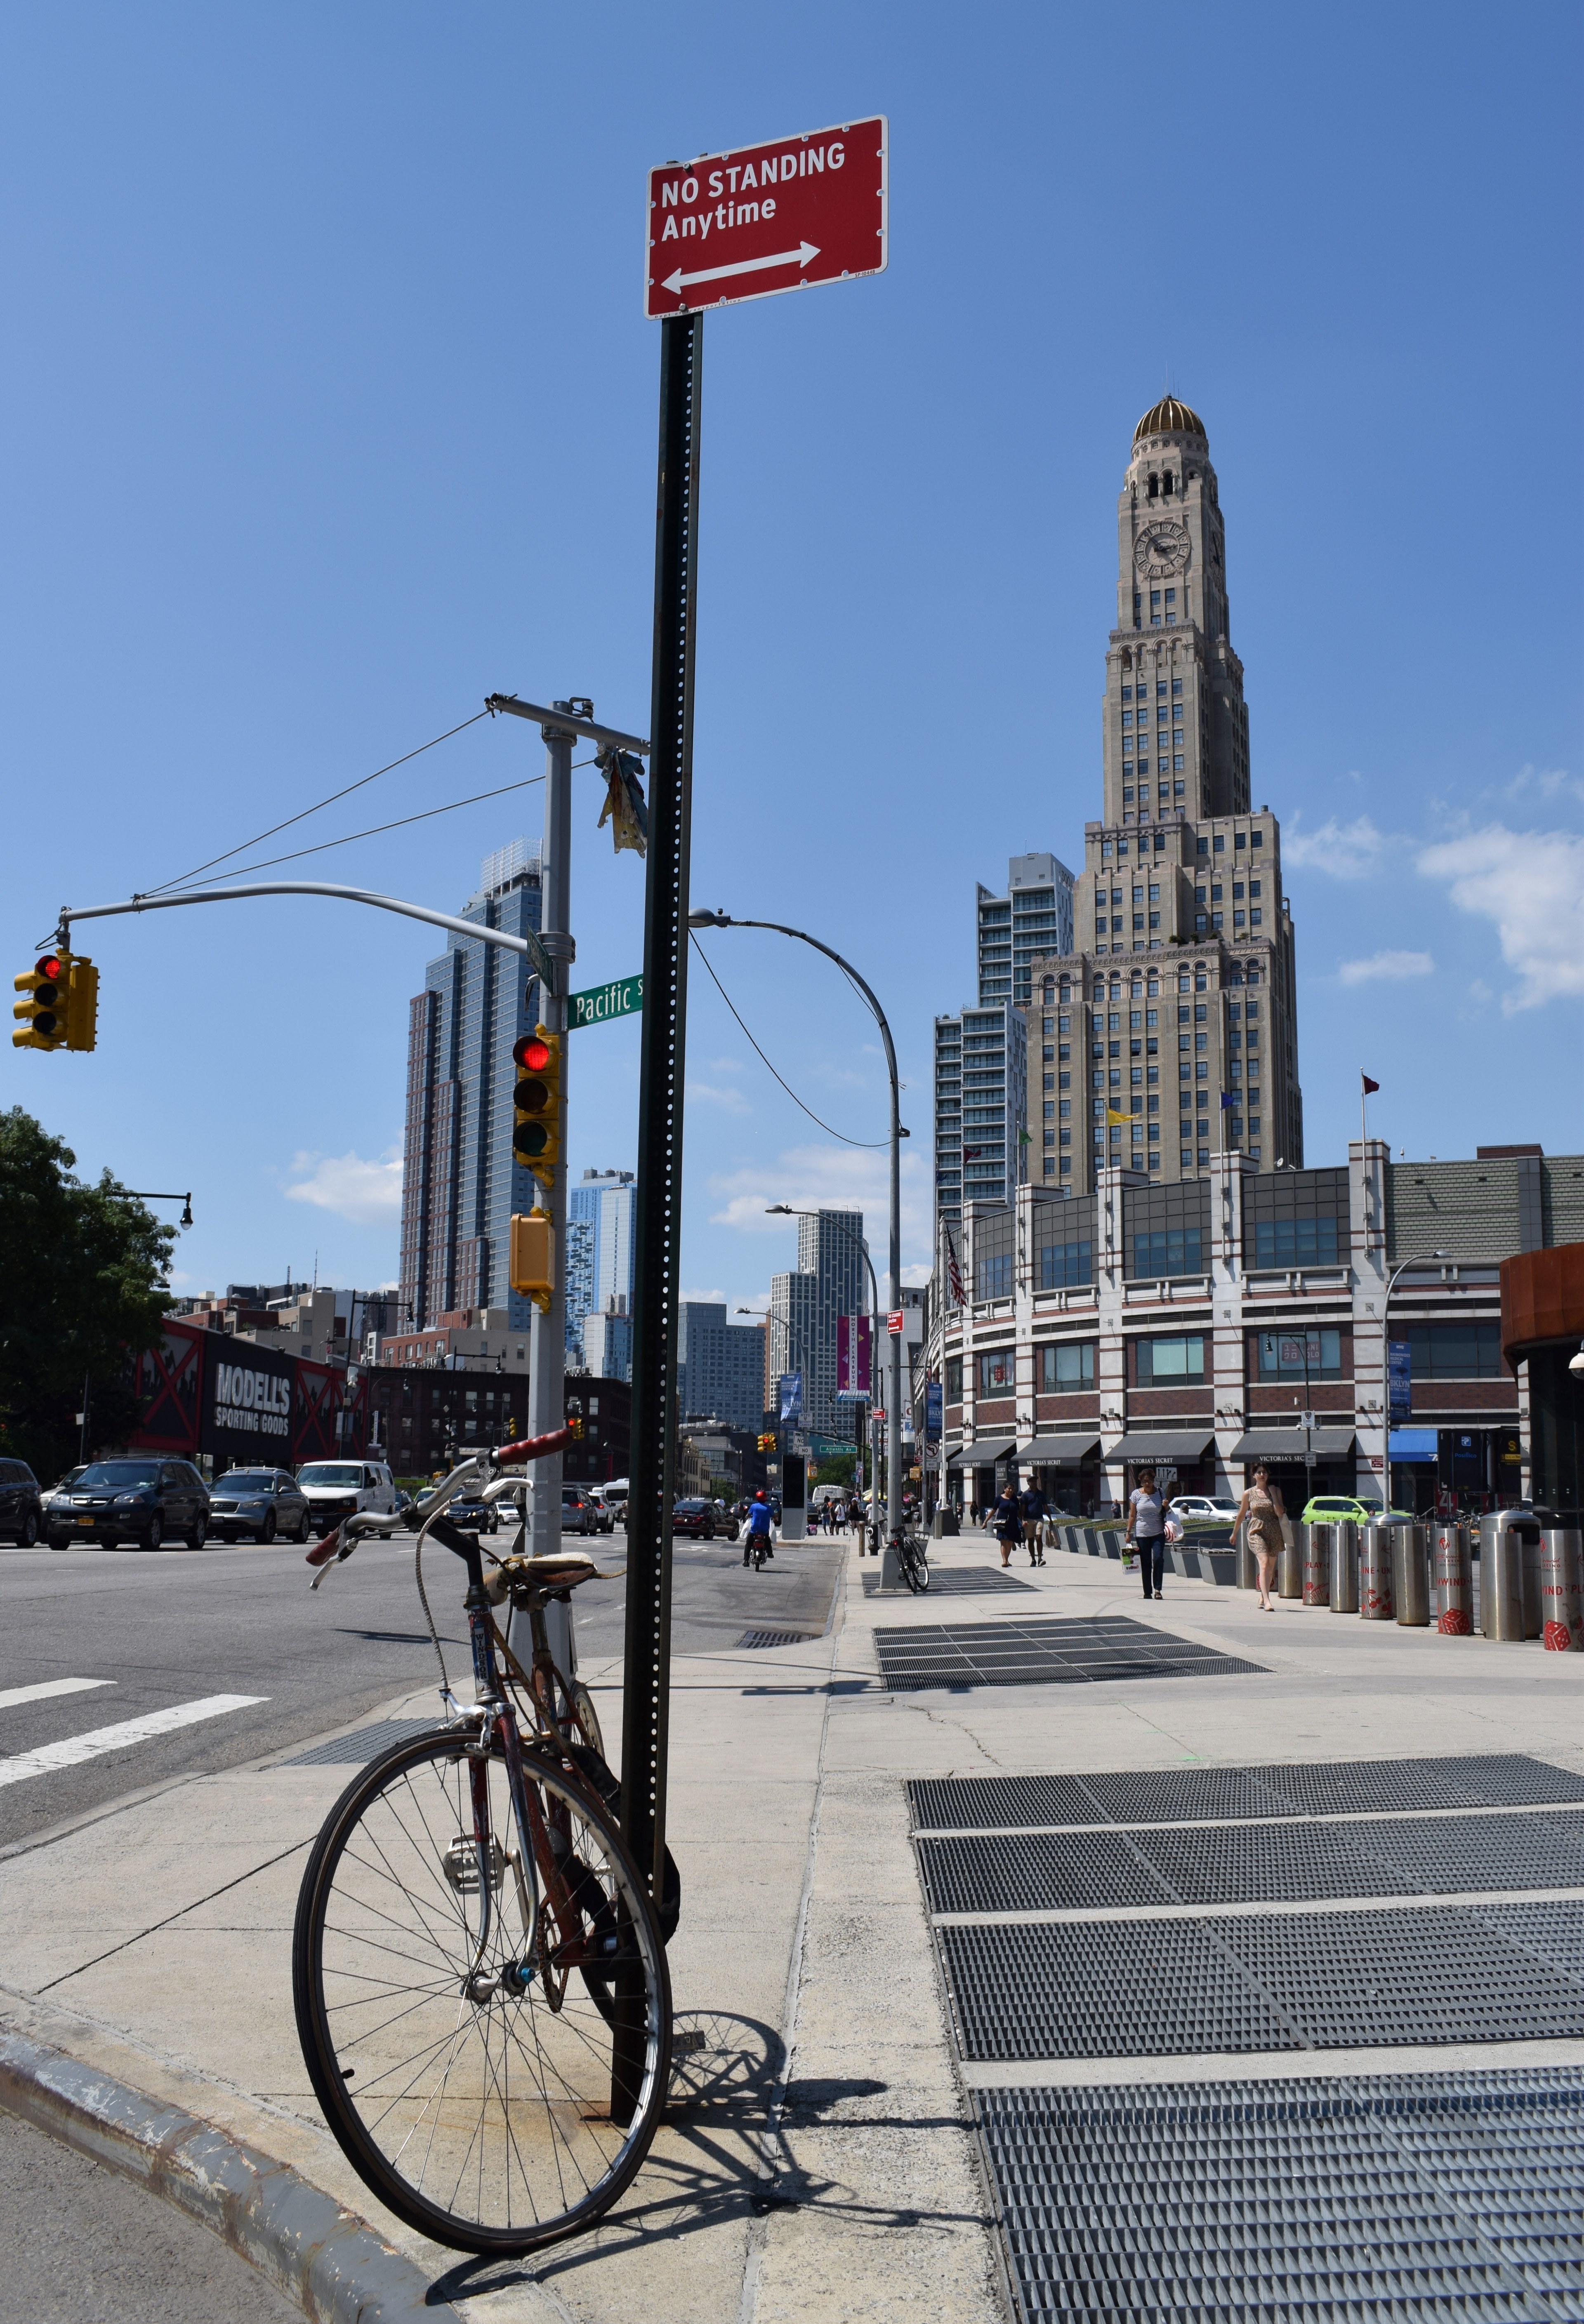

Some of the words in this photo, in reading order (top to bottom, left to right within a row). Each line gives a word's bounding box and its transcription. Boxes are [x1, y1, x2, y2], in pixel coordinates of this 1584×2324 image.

[662, 177, 699, 208] NO
[708, 142, 845, 198] STANDING
[662, 198, 776, 241] Anytime
[855, 269, 875, 278] SP-1044B
[577, 983, 631, 1023] Pacific
[638, 979, 643, 996] S
[215, 1363, 290, 1415] MODELL'S
[1390, 1379, 1410, 1388] BKLYN
[214, 1406, 259, 1432] SPORTING
[261, 1414, 289, 1436] GOODS
[1437, 1578, 1466, 1587] WIND
[1542, 1586, 1563, 1595] IND
[476, 1634, 487, 1679] WINDSOR
